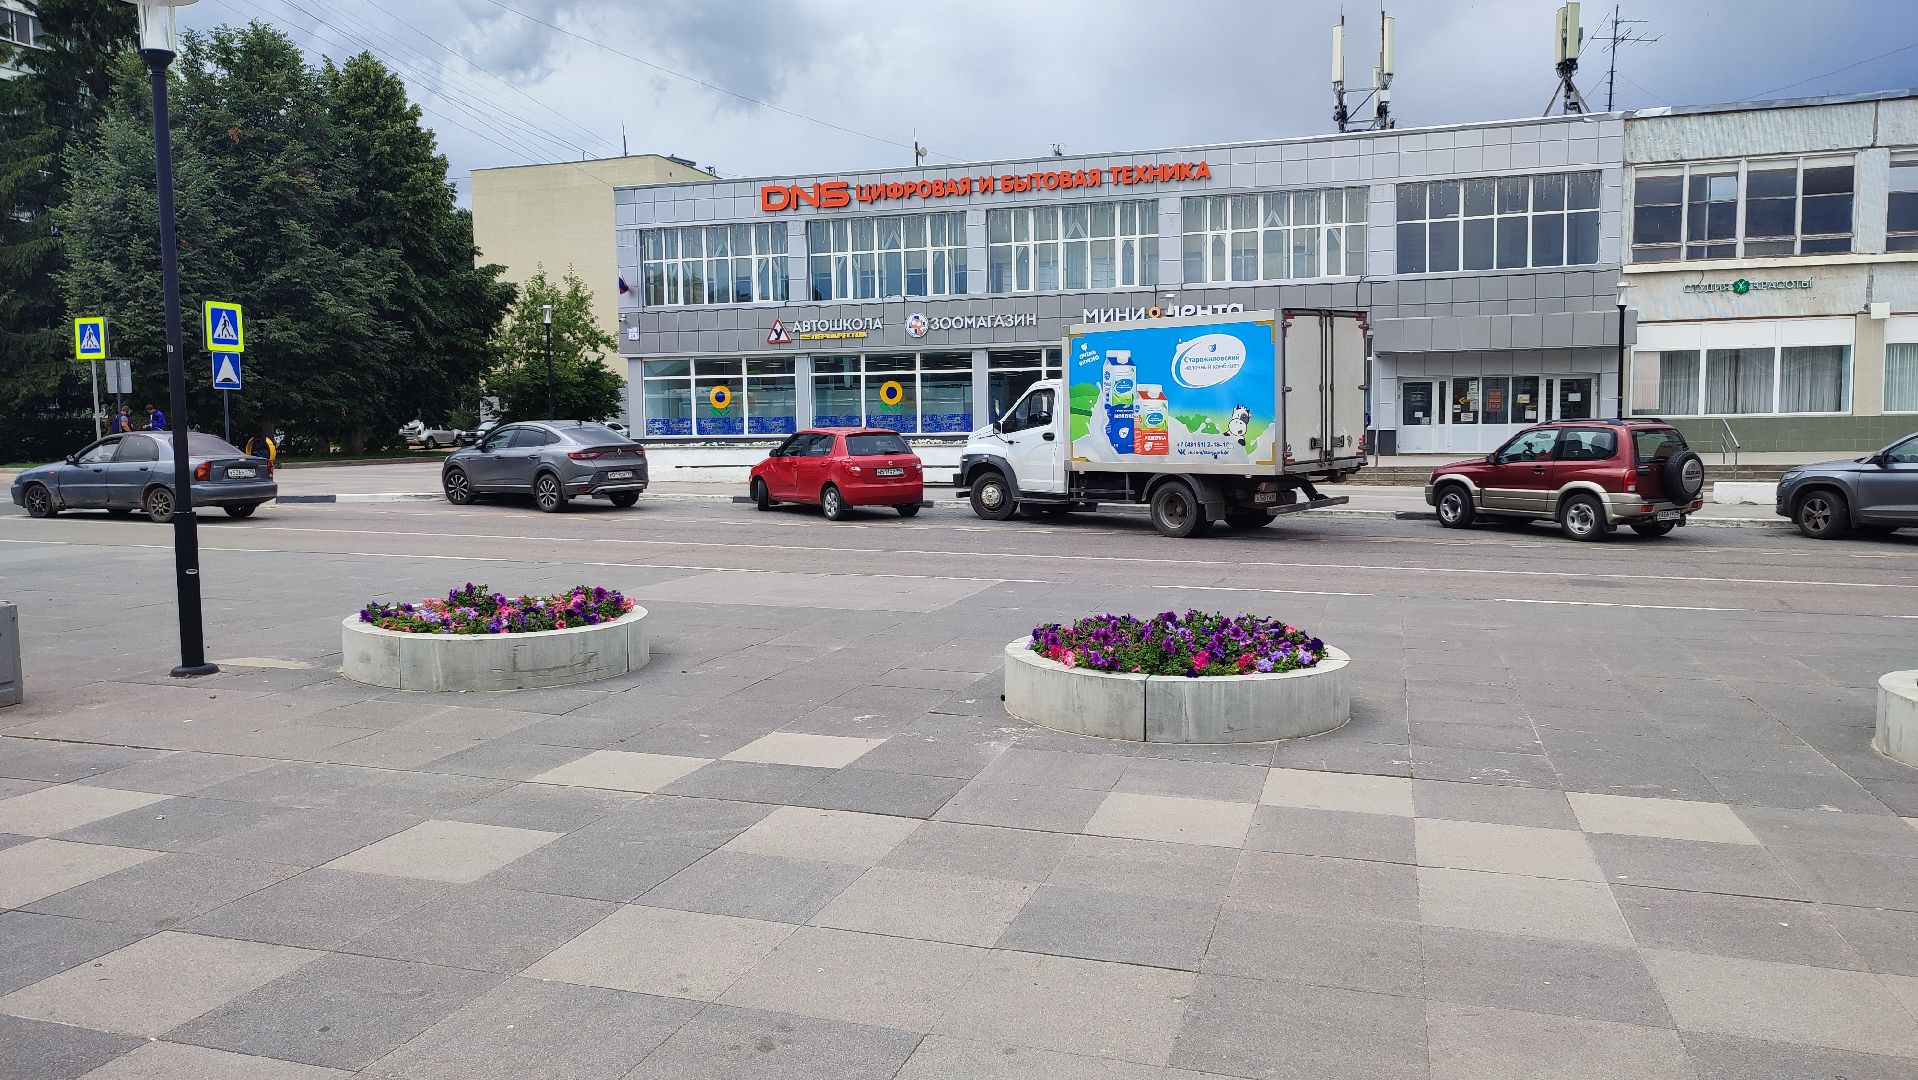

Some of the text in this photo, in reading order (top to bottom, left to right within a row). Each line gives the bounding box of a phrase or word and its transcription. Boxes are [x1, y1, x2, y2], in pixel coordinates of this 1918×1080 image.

[855, 161, 1212, 204] ЦИФРОВАЯ И БЫТОВАЯ ТЕХНИКА
[761, 181, 851, 212] DNS
[1683, 280, 1813, 293] СТУДИЯ КРАСОТЫ
[931, 313, 1037, 330] ЗООМАГАЗИН
[1083, 306, 1146, 324] МИНИ
[792, 317, 883, 333] АВТОШКОЛА
[1184, 353, 1240, 363] Старожиловский
